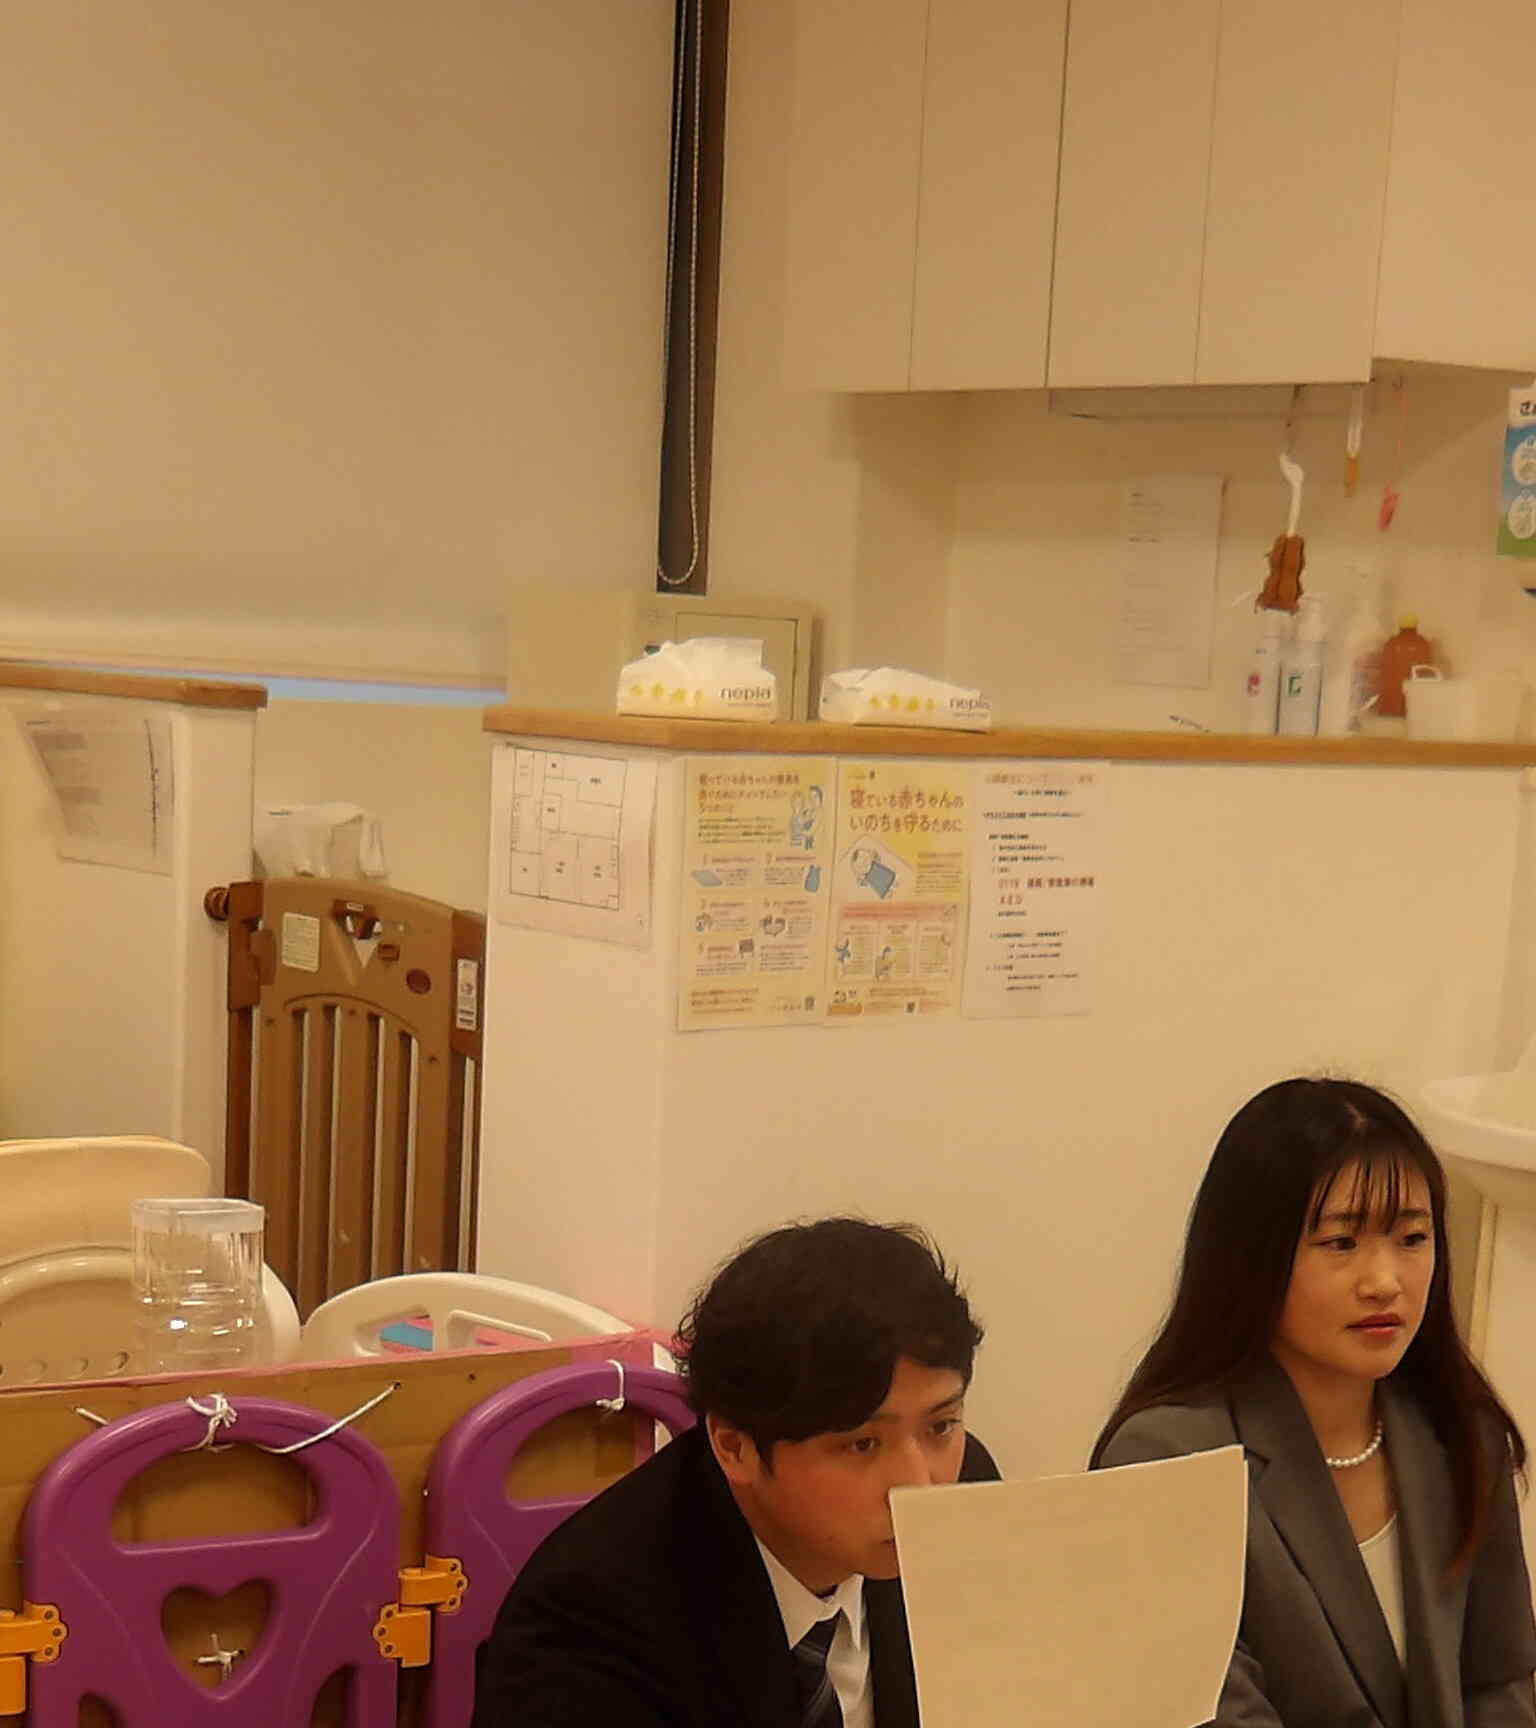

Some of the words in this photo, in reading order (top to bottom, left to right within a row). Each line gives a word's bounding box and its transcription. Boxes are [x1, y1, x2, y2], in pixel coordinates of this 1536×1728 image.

[850, 784, 964, 810] 寝ている赤ちゃんの
[850, 812, 963, 834] いのちを守るために
